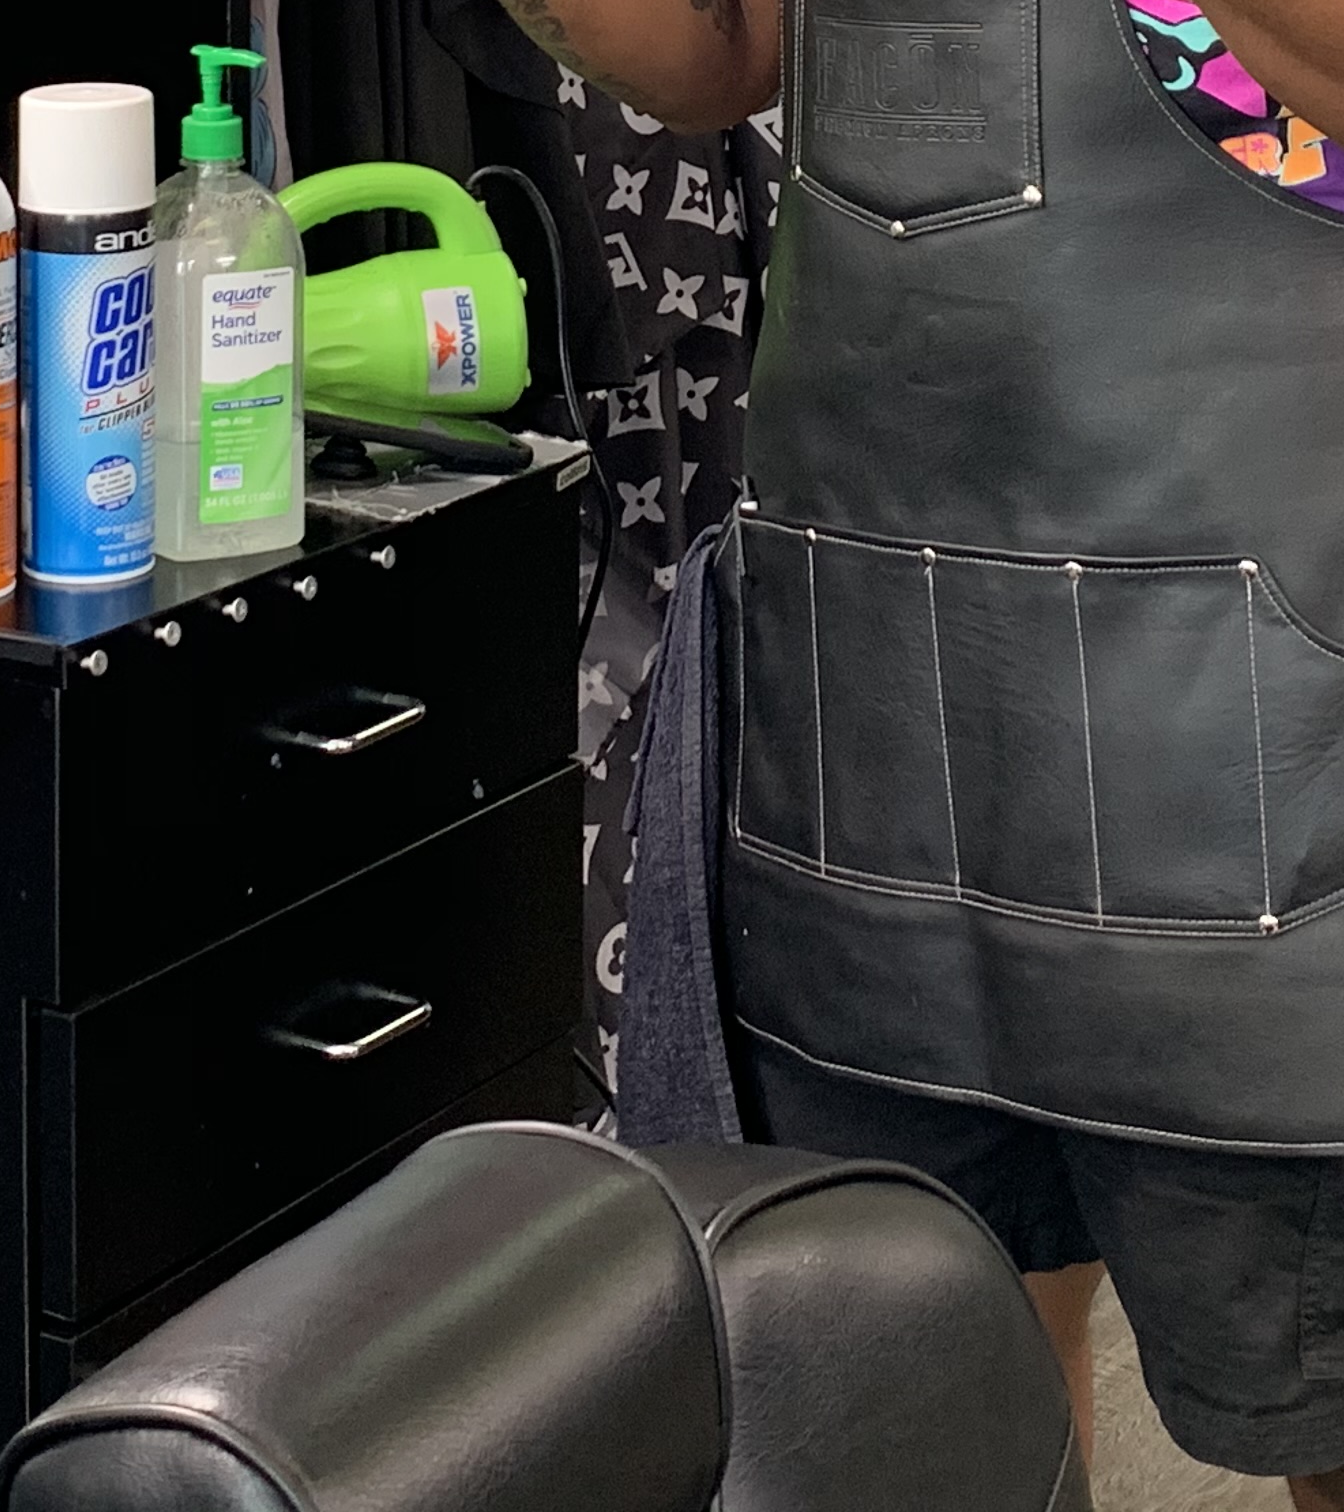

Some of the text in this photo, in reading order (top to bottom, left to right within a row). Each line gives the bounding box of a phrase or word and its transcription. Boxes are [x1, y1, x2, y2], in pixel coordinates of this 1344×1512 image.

[212, 285, 273, 306] equate
[212, 311, 256, 329] Hand
[212, 330, 282, 348] Sanitizer
[456, 293, 477, 386] XPOWER
